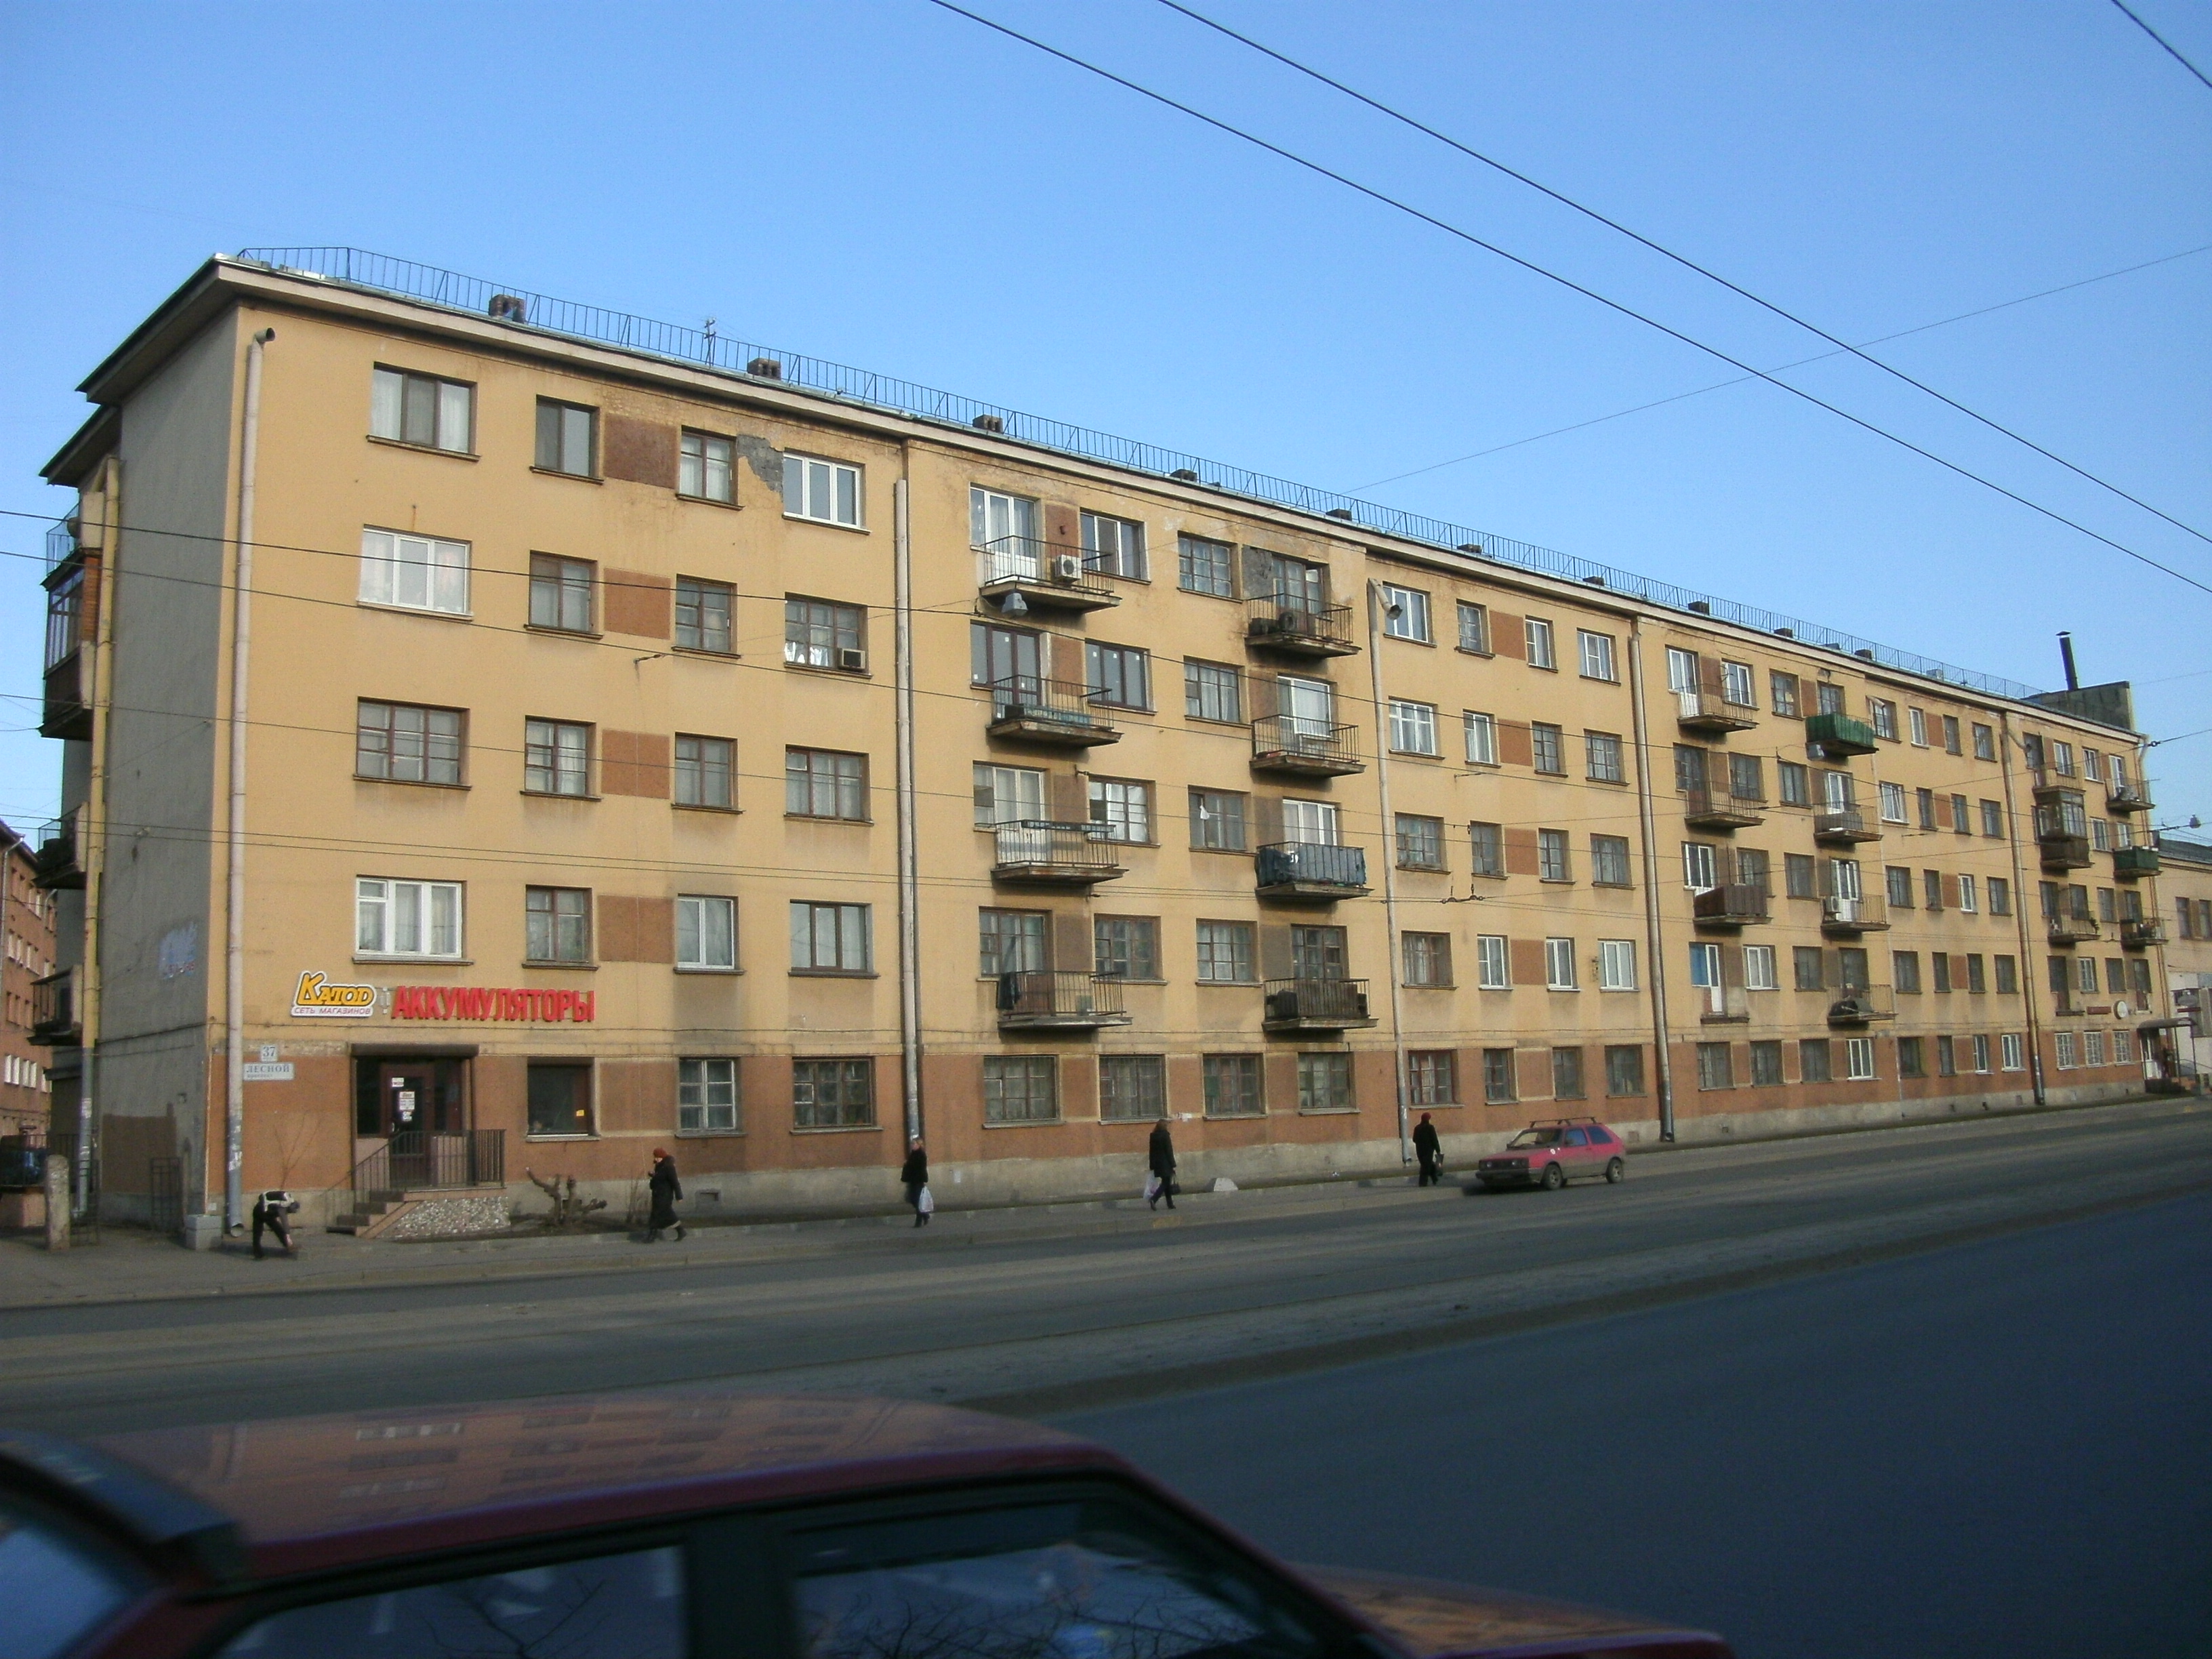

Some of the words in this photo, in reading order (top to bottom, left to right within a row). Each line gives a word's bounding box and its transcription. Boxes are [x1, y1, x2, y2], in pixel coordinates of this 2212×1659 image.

[391, 985, 595, 1022] АККУМУЛЯТОРЫ
[263, 1046, 275, 1057] 37
[246, 1063, 289, 1073] ЛЕСНОЙ
